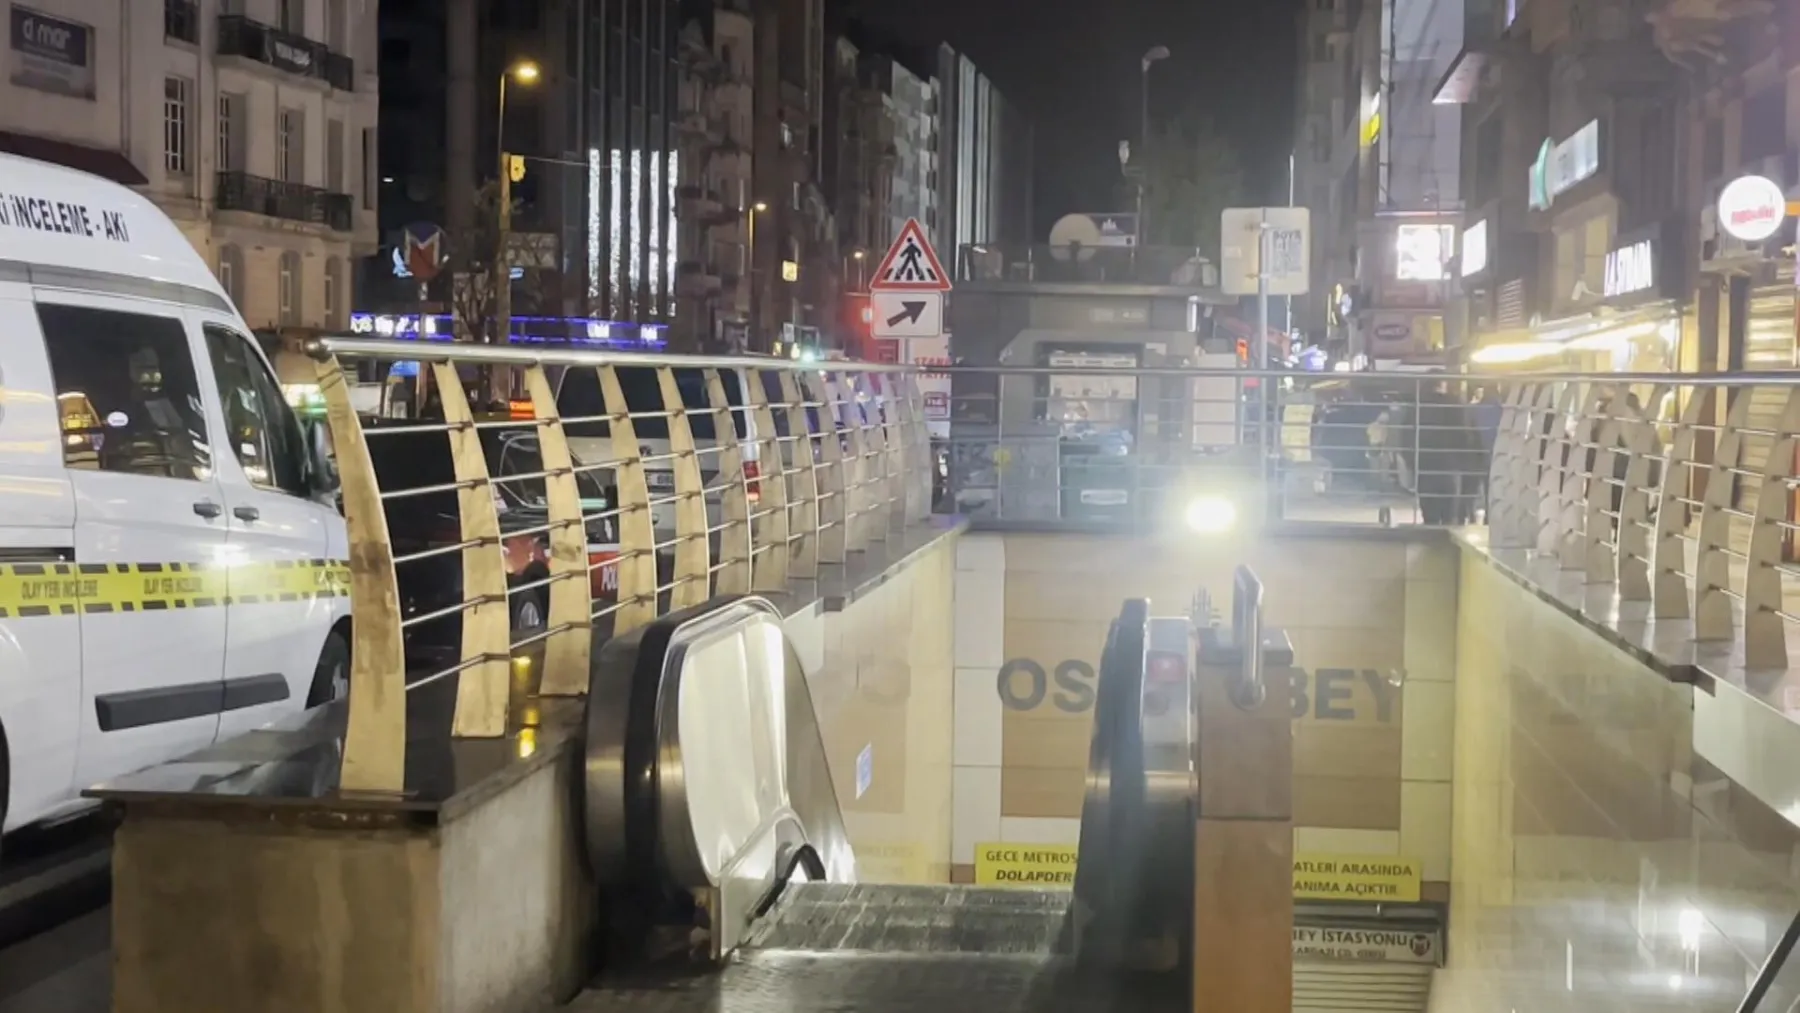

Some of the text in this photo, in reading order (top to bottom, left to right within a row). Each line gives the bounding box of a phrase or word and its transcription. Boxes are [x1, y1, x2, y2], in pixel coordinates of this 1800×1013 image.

[9, 194, 93, 237] İNCELEME
[986, 850, 1019, 863] GECE
[1341, 863, 1412, 876] ARASINDA
[1345, 882, 1397, 896] AÇIKTIR
[1322, 928, 1407, 946] İSTASYONU
